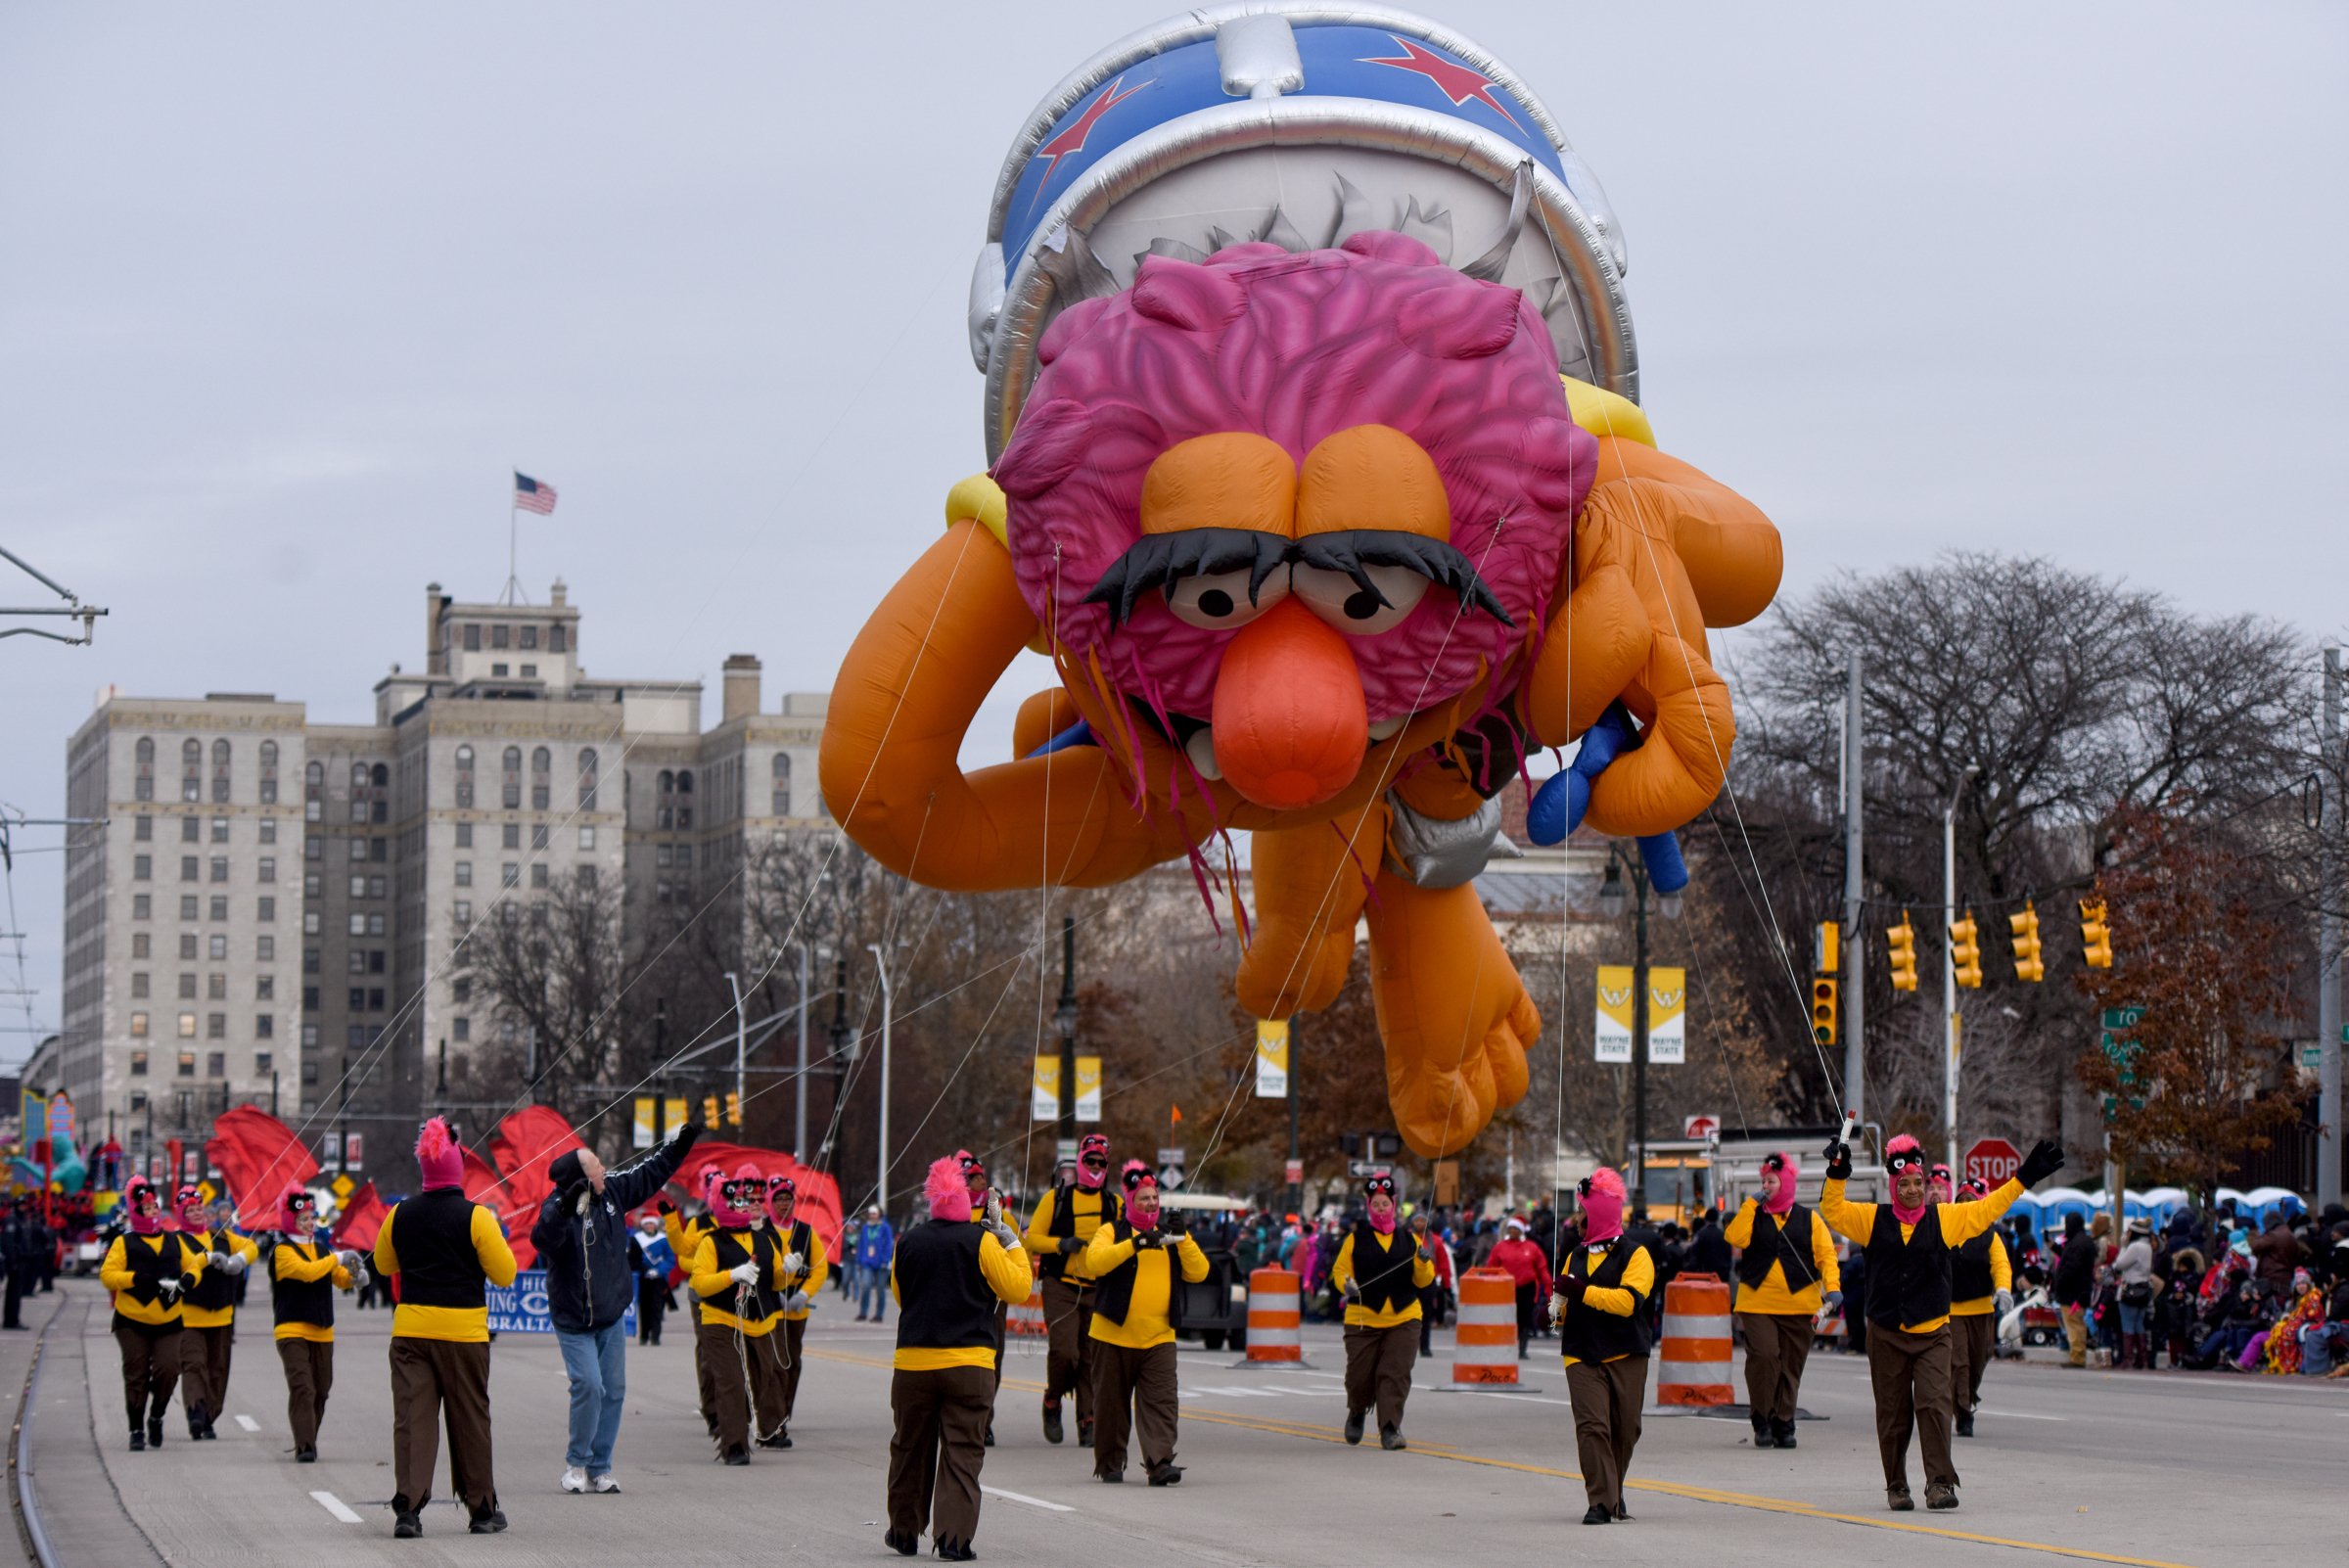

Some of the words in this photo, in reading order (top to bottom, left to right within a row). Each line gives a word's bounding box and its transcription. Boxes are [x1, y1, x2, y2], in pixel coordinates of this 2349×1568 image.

[1599, 1036, 1629, 1045] WAYNE
[1651, 1038, 1681, 1046] WAYNE
[1601, 1044, 1627, 1054] STATE
[1654, 1046, 1680, 1055] STATE
[1968, 1157, 2018, 1179] STOP
